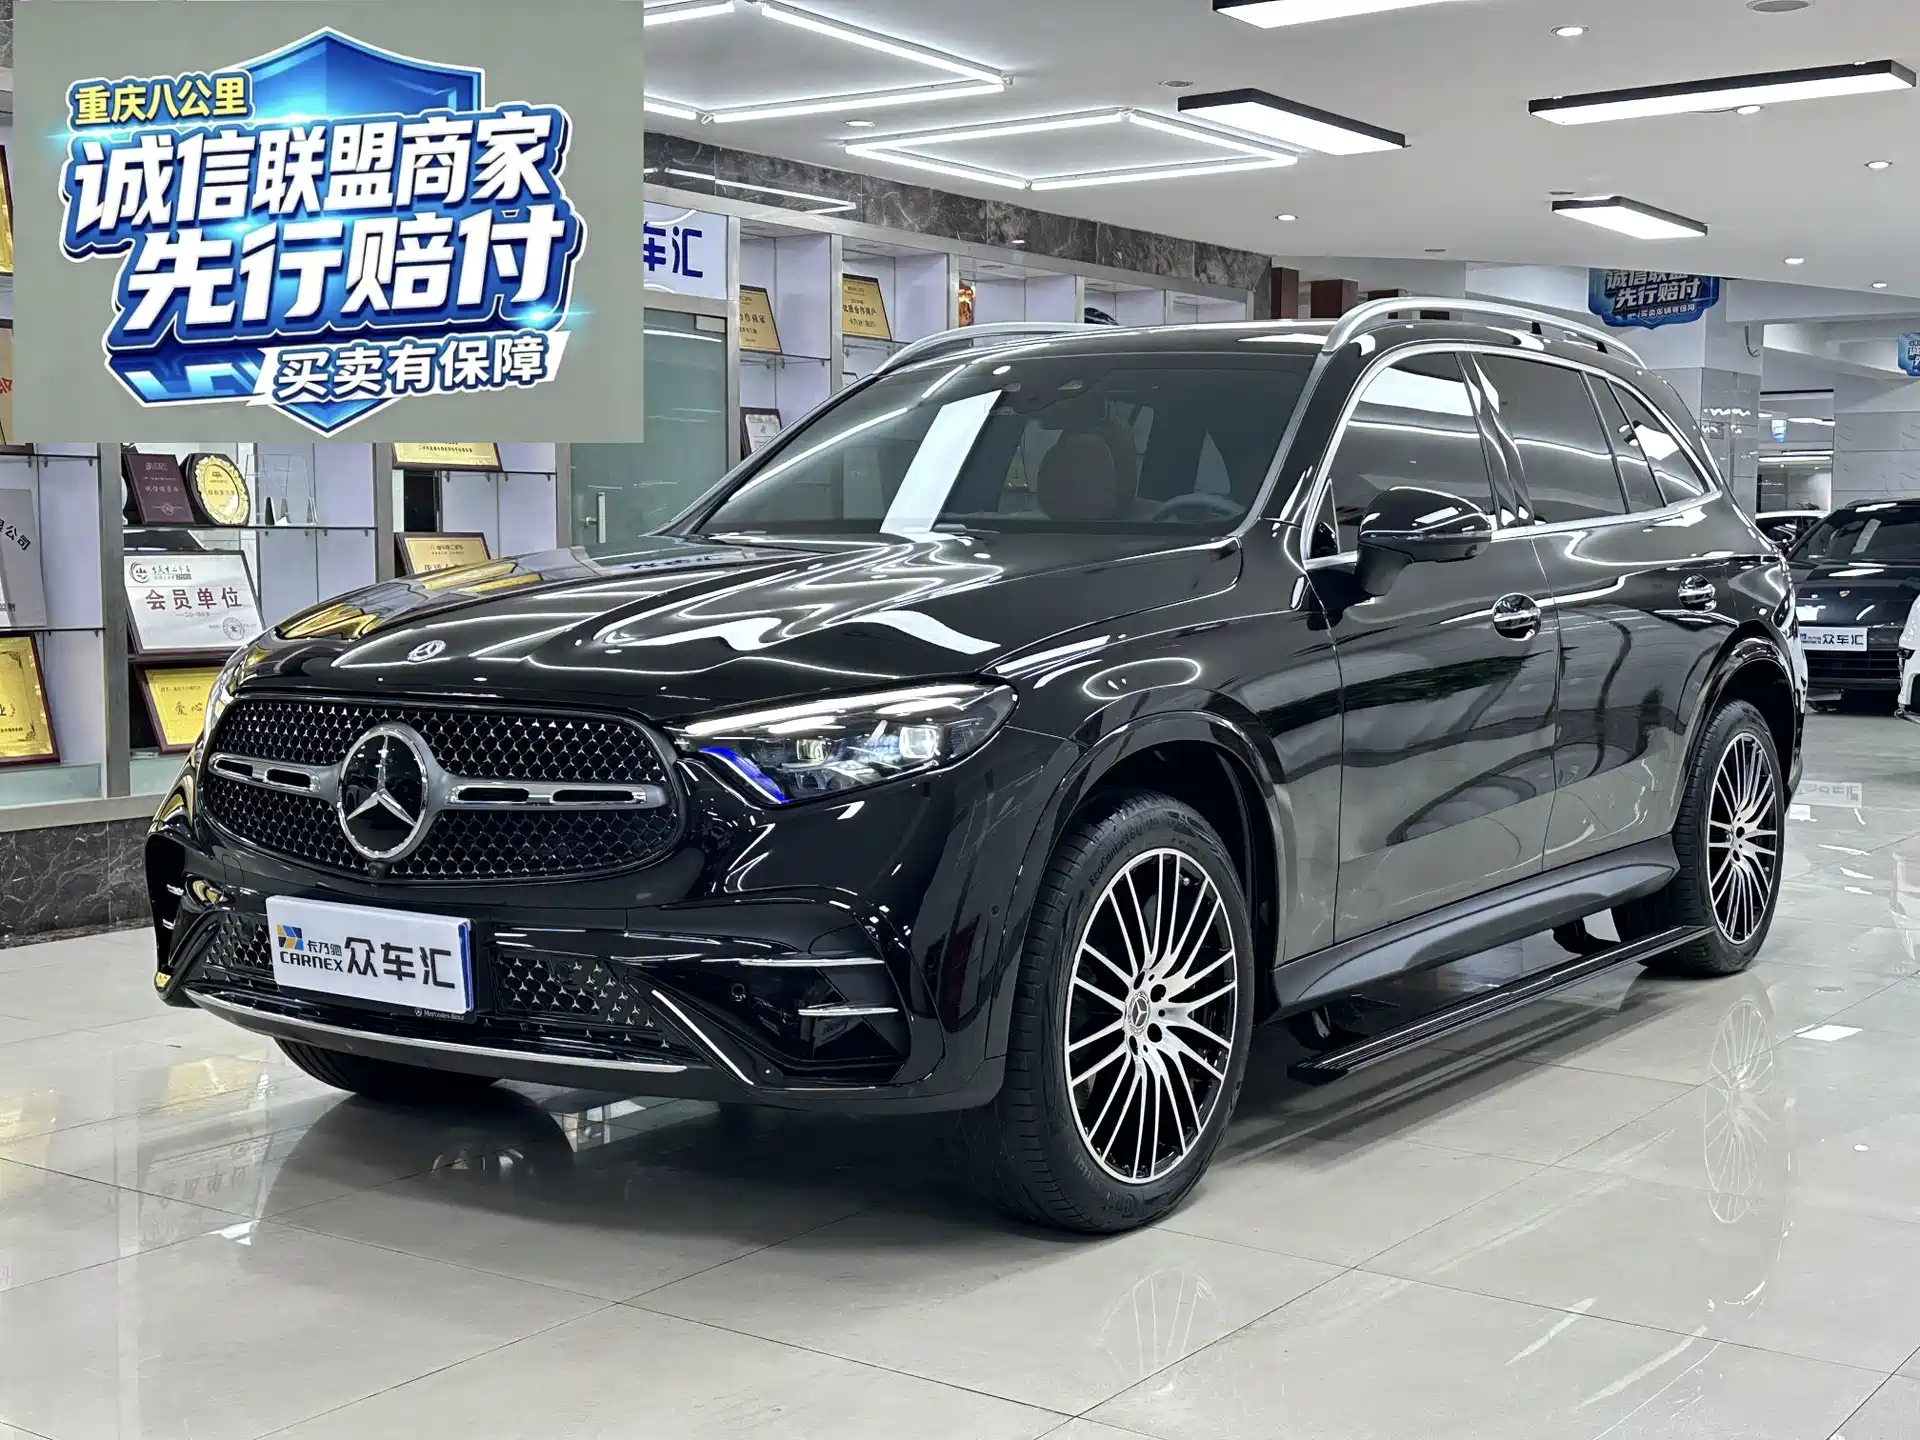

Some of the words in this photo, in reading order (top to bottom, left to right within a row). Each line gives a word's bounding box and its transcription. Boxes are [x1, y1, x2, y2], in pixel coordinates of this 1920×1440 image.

[1616, 278, 1700, 308] 先行赔付
[145, 587, 242, 610] 会员单位
[1822, 633, 1864, 645] 众车汇
[280, 951, 344, 973] CARNEX
[307, 939, 342, 957] 卡乃驰
[344, 936, 456, 990] 众车汇
